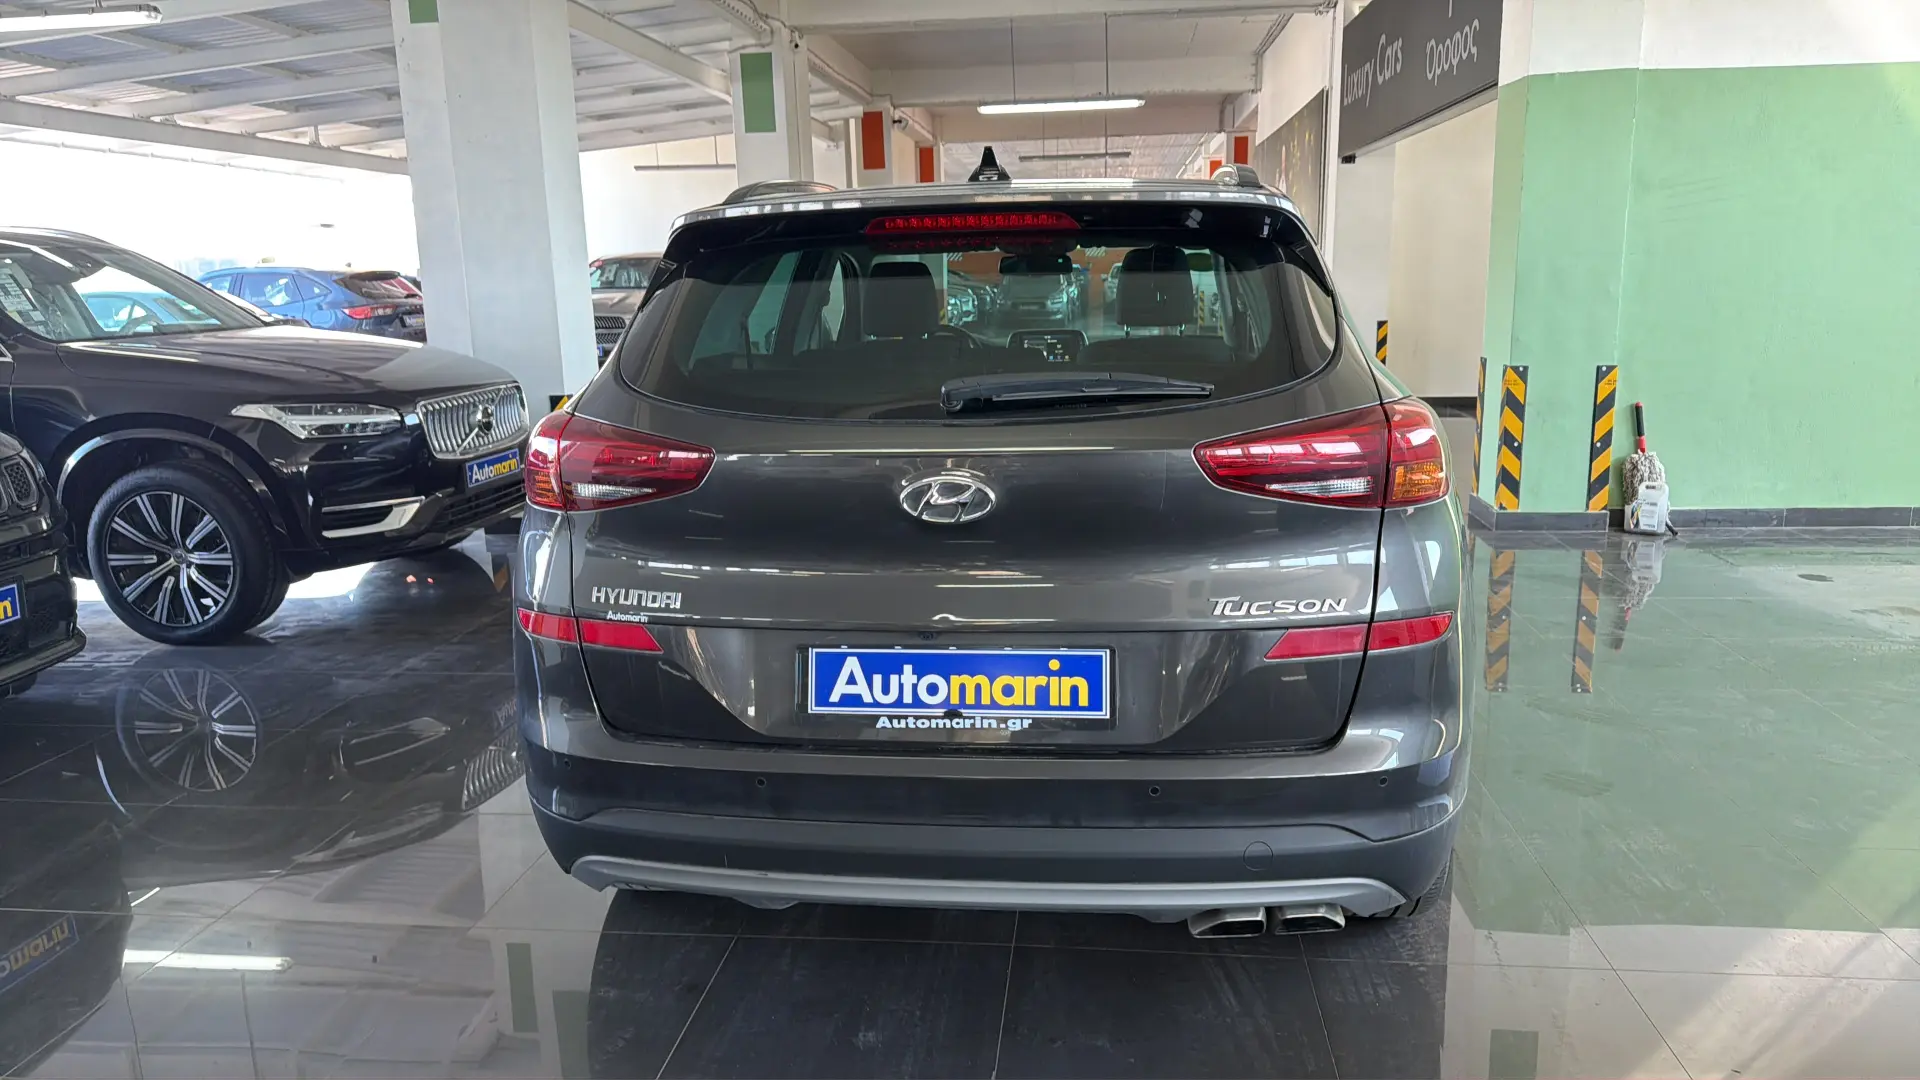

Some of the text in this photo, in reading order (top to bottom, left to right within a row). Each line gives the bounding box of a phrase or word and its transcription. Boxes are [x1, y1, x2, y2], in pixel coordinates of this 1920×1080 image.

[1343, 33, 1403, 108] Luxury Cars
[471, 454, 518, 483] Automarin
[591, 586, 682, 609] HYUNDAI
[606, 610, 649, 623] Automarin
[828, 656, 1089, 707] Automarin
[875, 715, 1033, 731] Automarin.gr
